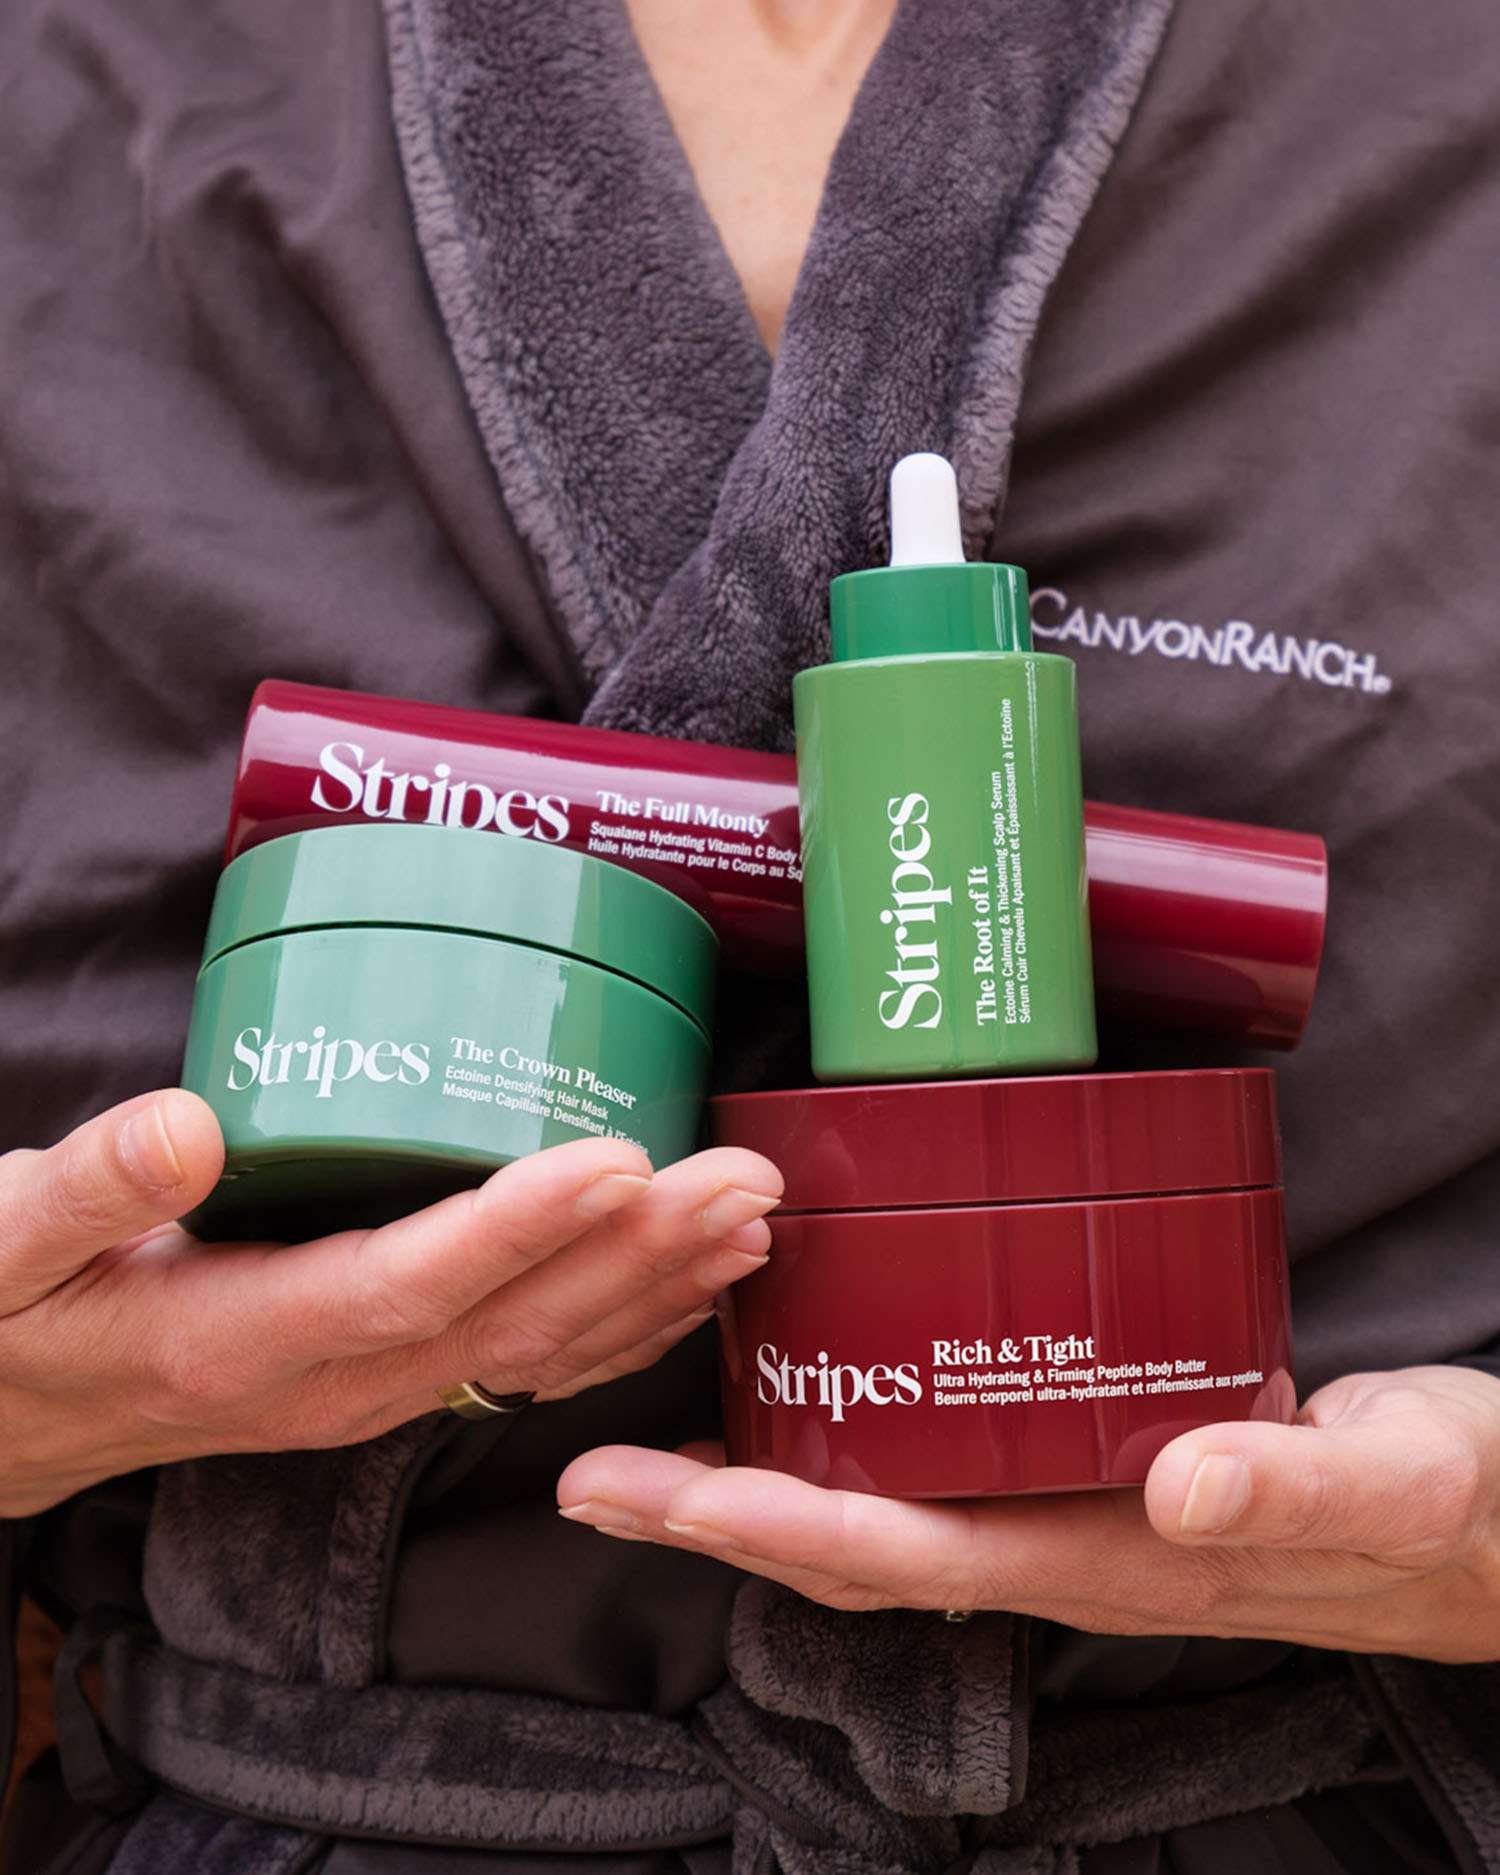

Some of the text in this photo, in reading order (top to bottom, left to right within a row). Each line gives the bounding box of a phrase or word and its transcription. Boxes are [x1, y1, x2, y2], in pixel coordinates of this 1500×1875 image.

[311, 741, 570, 842] Stripes
[596, 790, 769, 838] The Full Monty
[588, 838, 618, 854] Huile
[621, 843, 685, 865] Hydratante
[688, 852, 716, 867] pour
[718, 856, 730, 870] le
[732, 858, 766, 876] Corps
[769, 866, 785, 878] au
[591, 821, 647, 842] Squalane
[649, 830, 706, 853] Hydrating
[707, 838, 752, 856] Vitamin
[755, 845, 765, 858] C
[767, 848, 797, 865] Body
[1010, 838, 1020, 850] et
[991, 771, 1016, 1024] Ectoine Calming & Thickening Scalp Serum
[1010, 852, 1024, 905] Apaisant
[879, 792, 953, 1029] Stripes
[1014, 907, 1027, 955] Chevelu
[968, 865, 997, 1025] The Root of It
[1016, 957, 1028, 982] Cuir
[1018, 985, 1031, 1024] Sérum
[227, 1025, 430, 1098] Stripes
[450, 1036, 636, 1110] The Crown Pleaser
[442, 1082, 493, 1103] Masque
[495, 1092, 551, 1117] Capillaire
[553, 1106, 606, 1137] Densifiant
[445, 1065, 609, 1120] Ectoine Densifying Hair Mask
[931, 1334, 1095, 1367] Rich & Tight
[933, 1360, 1207, 1389] Ultra Hydrating & Firming Peptide Body Butter
[756, 1342, 922, 1422] Stripes
[934, 1370, 1263, 1406] Beurre corporel ultra-hydratant et raffermissant aux peptides
